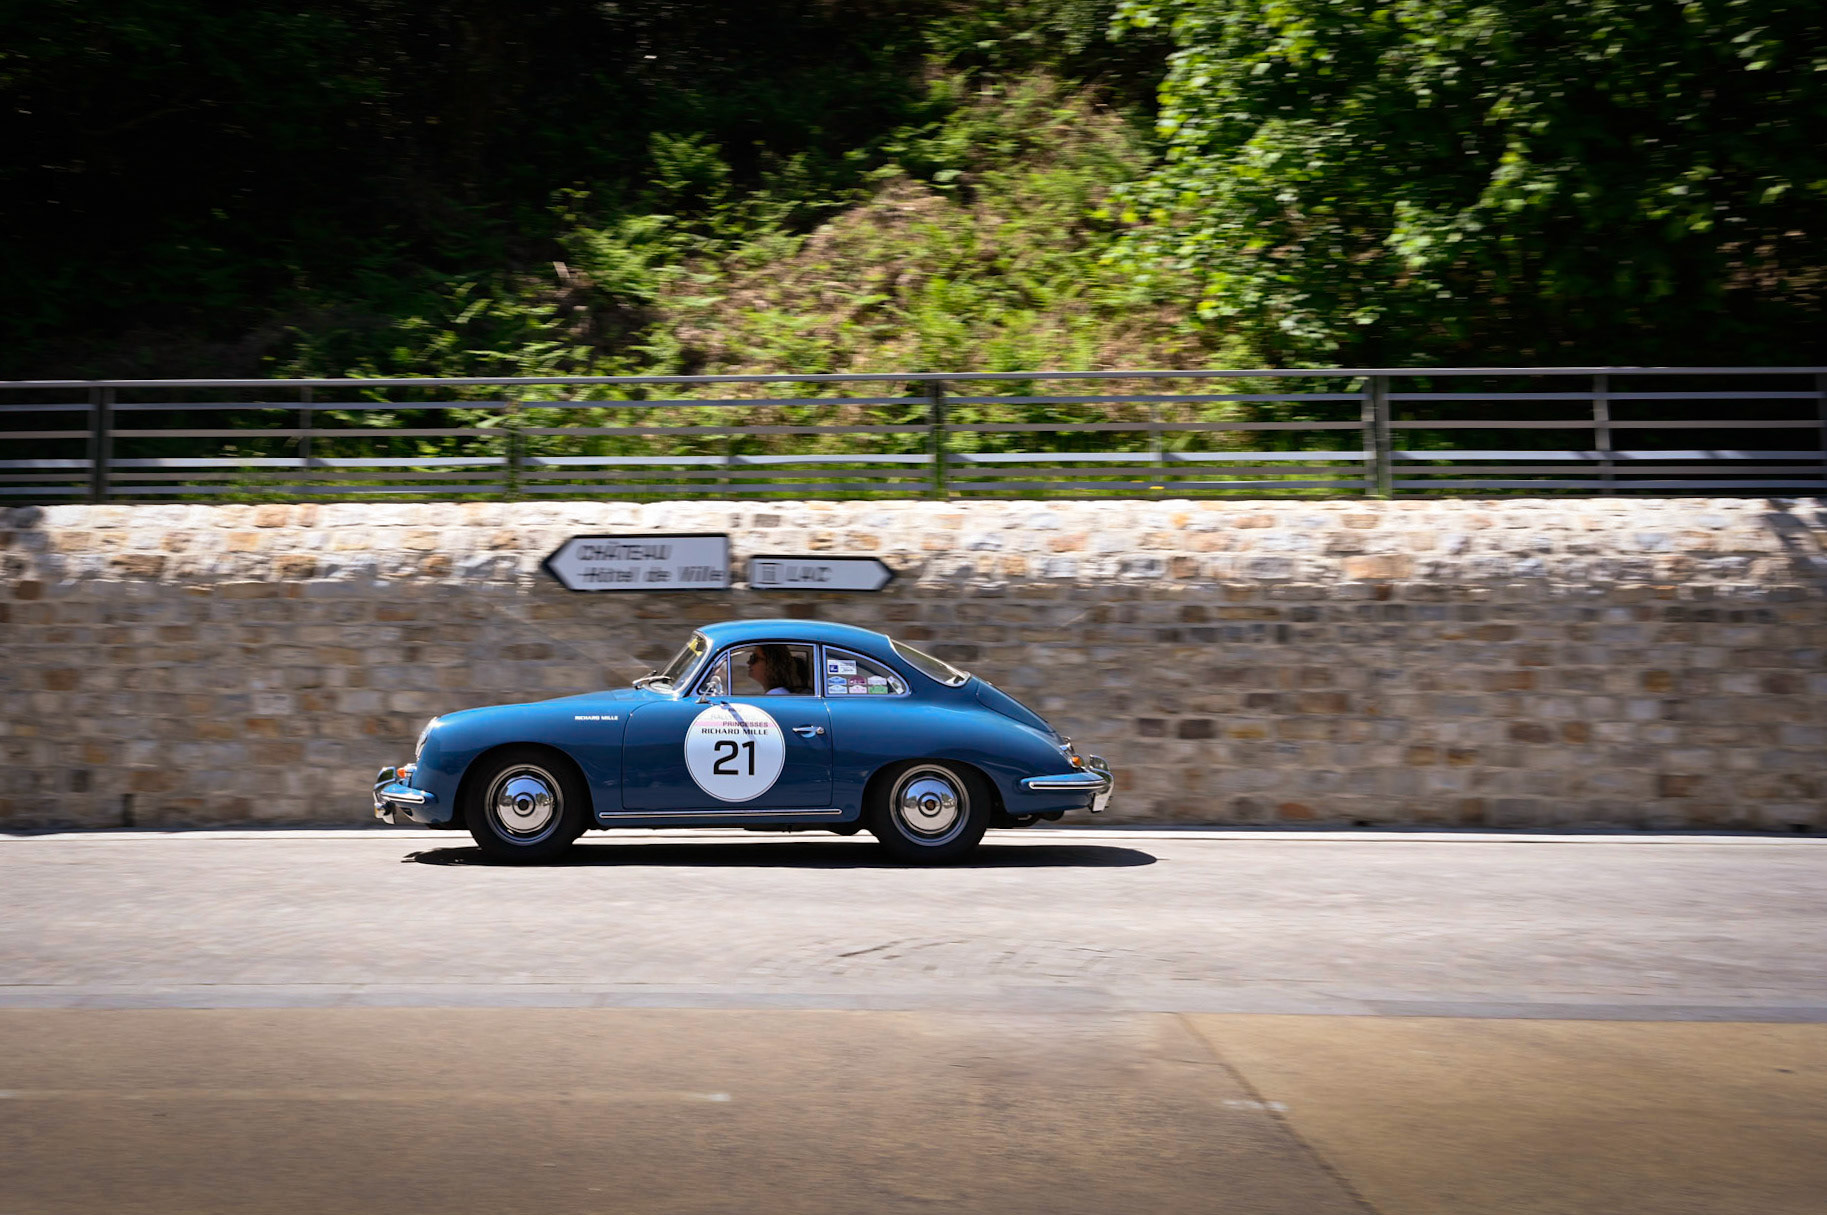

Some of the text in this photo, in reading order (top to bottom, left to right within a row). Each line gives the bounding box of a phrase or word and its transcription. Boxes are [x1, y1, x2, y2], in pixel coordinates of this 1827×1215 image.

[577, 541, 671, 560] CHÂTEAU
[579, 566, 724, 582] Hôtel de Ville
[786, 566, 832, 581] LAC
[714, 740, 754, 775] 21
